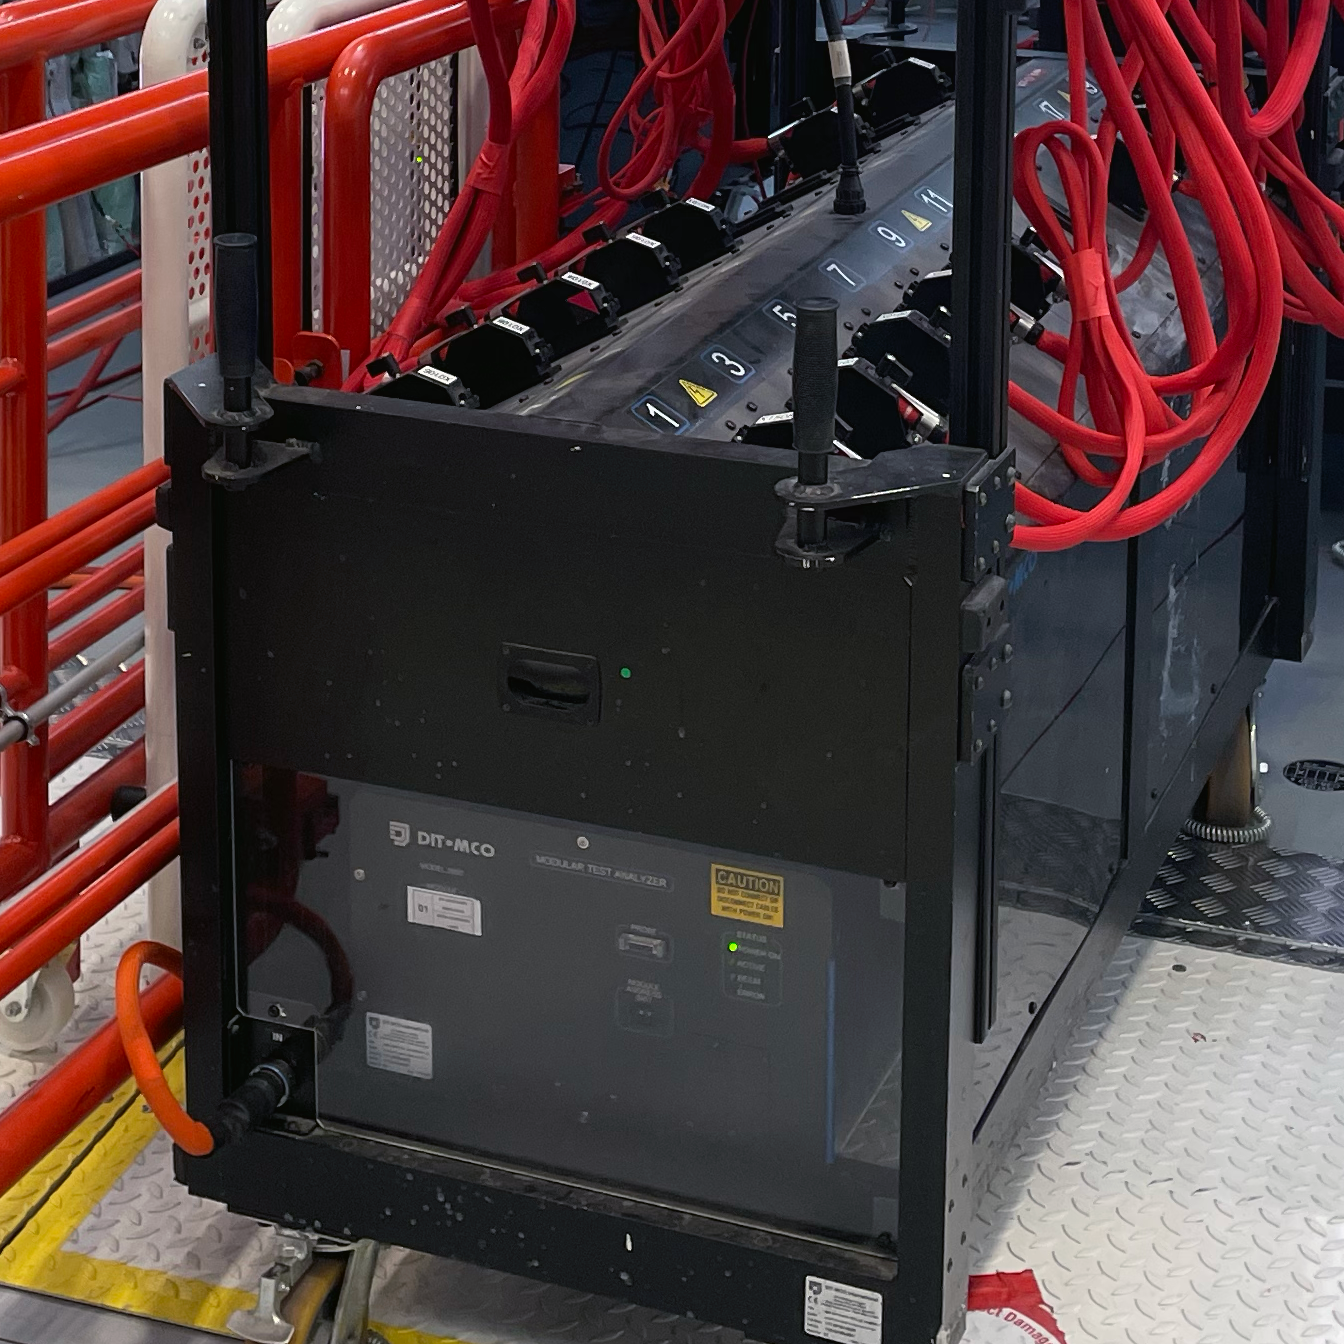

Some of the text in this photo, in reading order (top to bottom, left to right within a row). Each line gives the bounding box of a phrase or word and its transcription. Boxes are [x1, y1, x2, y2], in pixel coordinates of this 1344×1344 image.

[920, 188, 954, 213] 11
[877, 227, 907, 248] 9
[827, 263, 857, 287] 7
[772, 305, 797, 328] 5
[711, 351, 746, 377] 3
[646, 402, 680, 428] 1
[536, 853, 668, 889] MODULAR TEST ANALYZER
[717, 870, 779, 894] CAUTION
[417, 903, 429, 914] 01
[272, 1031, 283, 1043] IN
